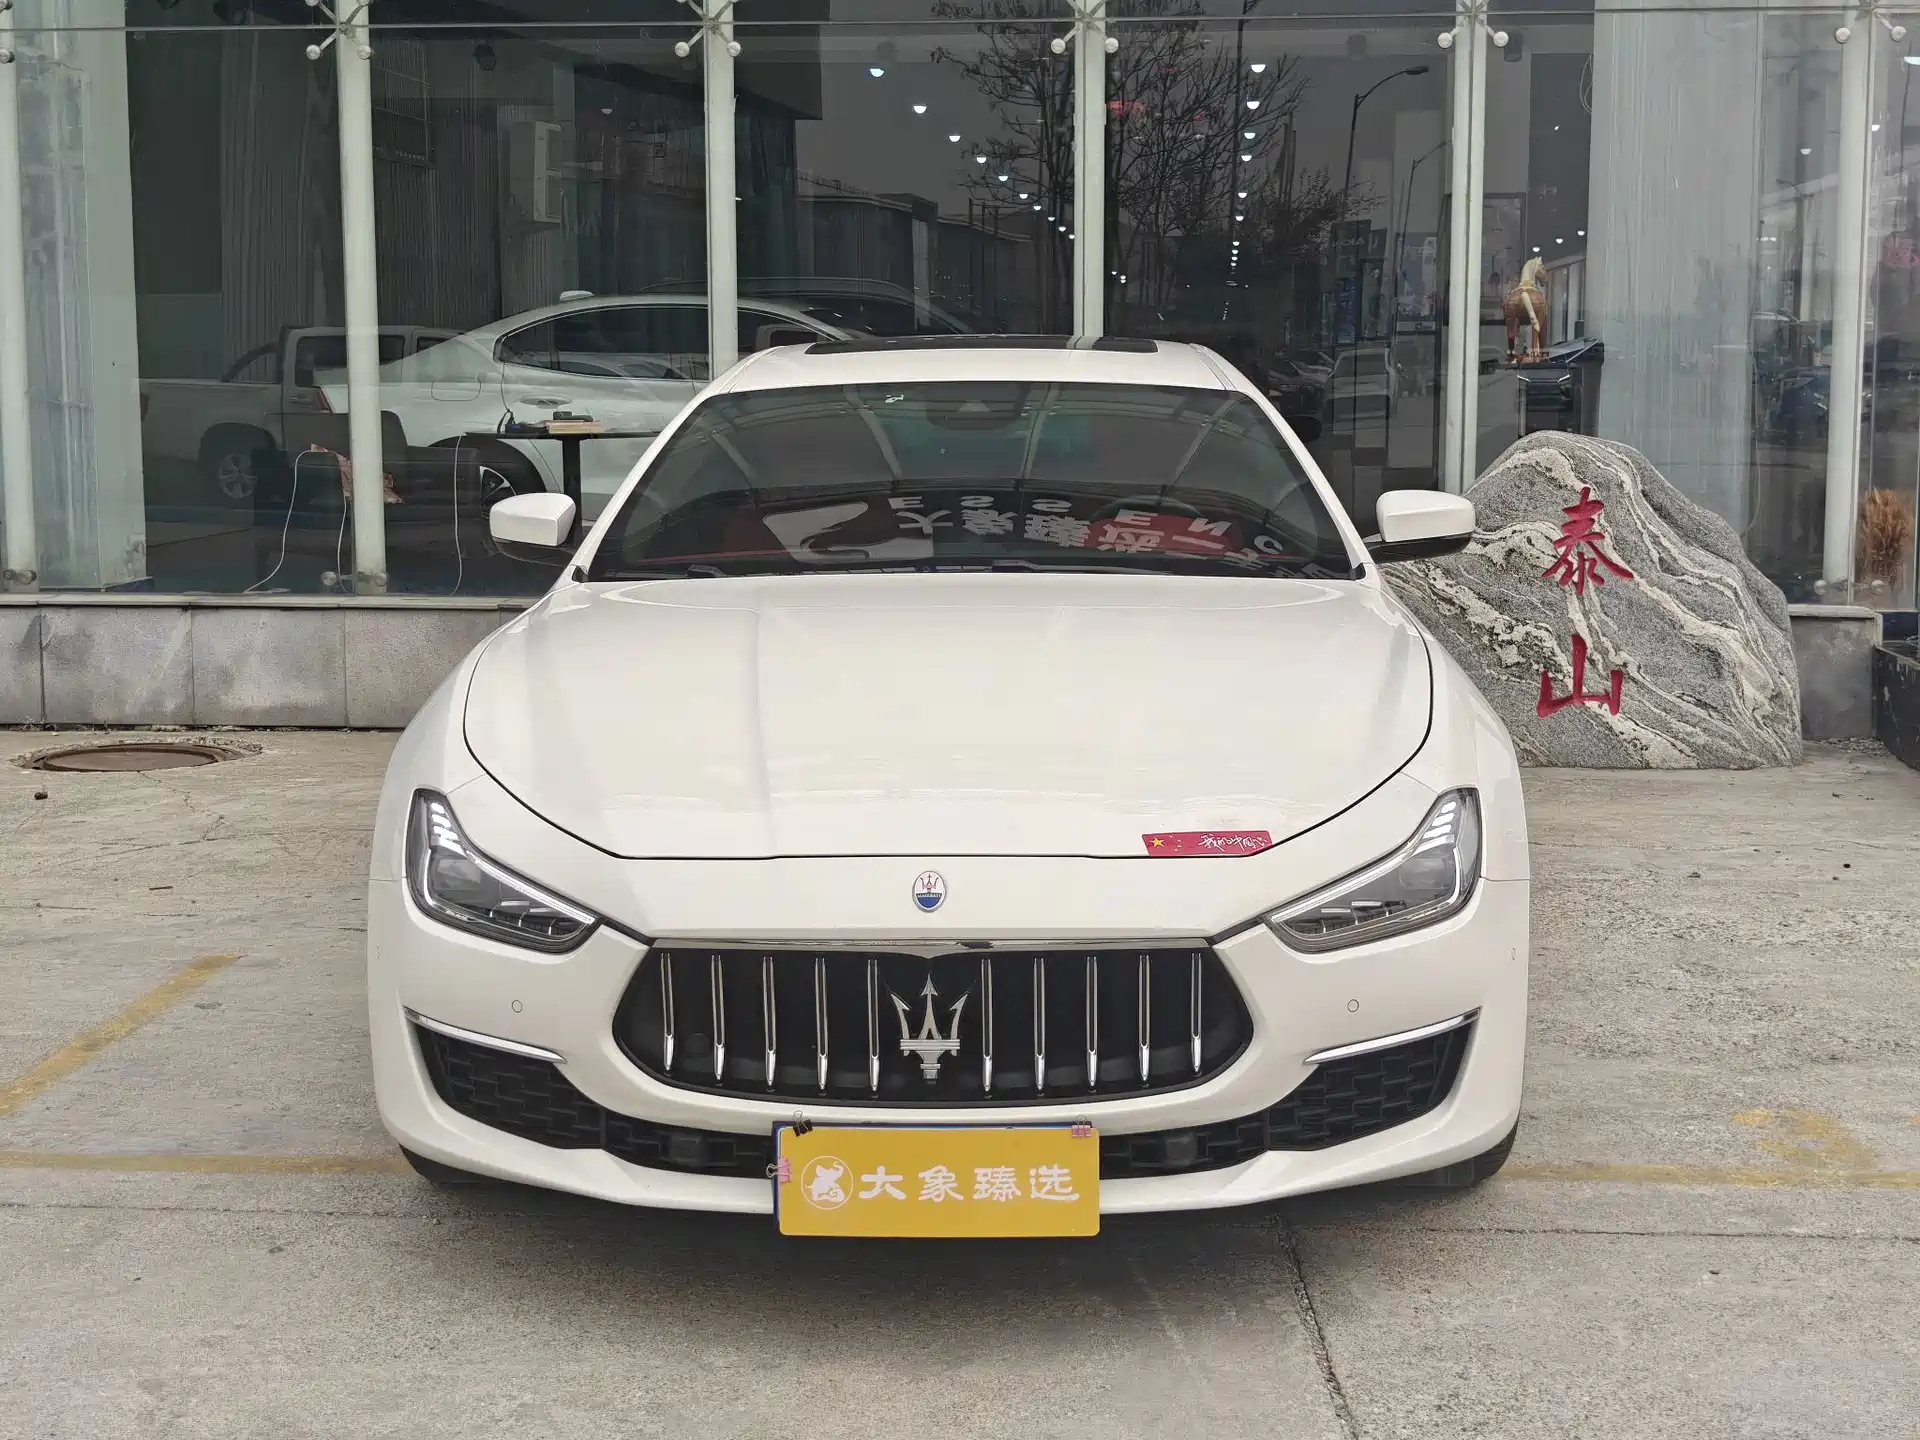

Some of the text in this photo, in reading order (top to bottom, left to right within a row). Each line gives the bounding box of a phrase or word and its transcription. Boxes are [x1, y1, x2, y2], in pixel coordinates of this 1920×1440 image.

[1536, 487, 1634, 718] 泰山
[1198, 834, 1268, 852] 我的中国心
[858, 1163, 1080, 1202] 大象臻选
